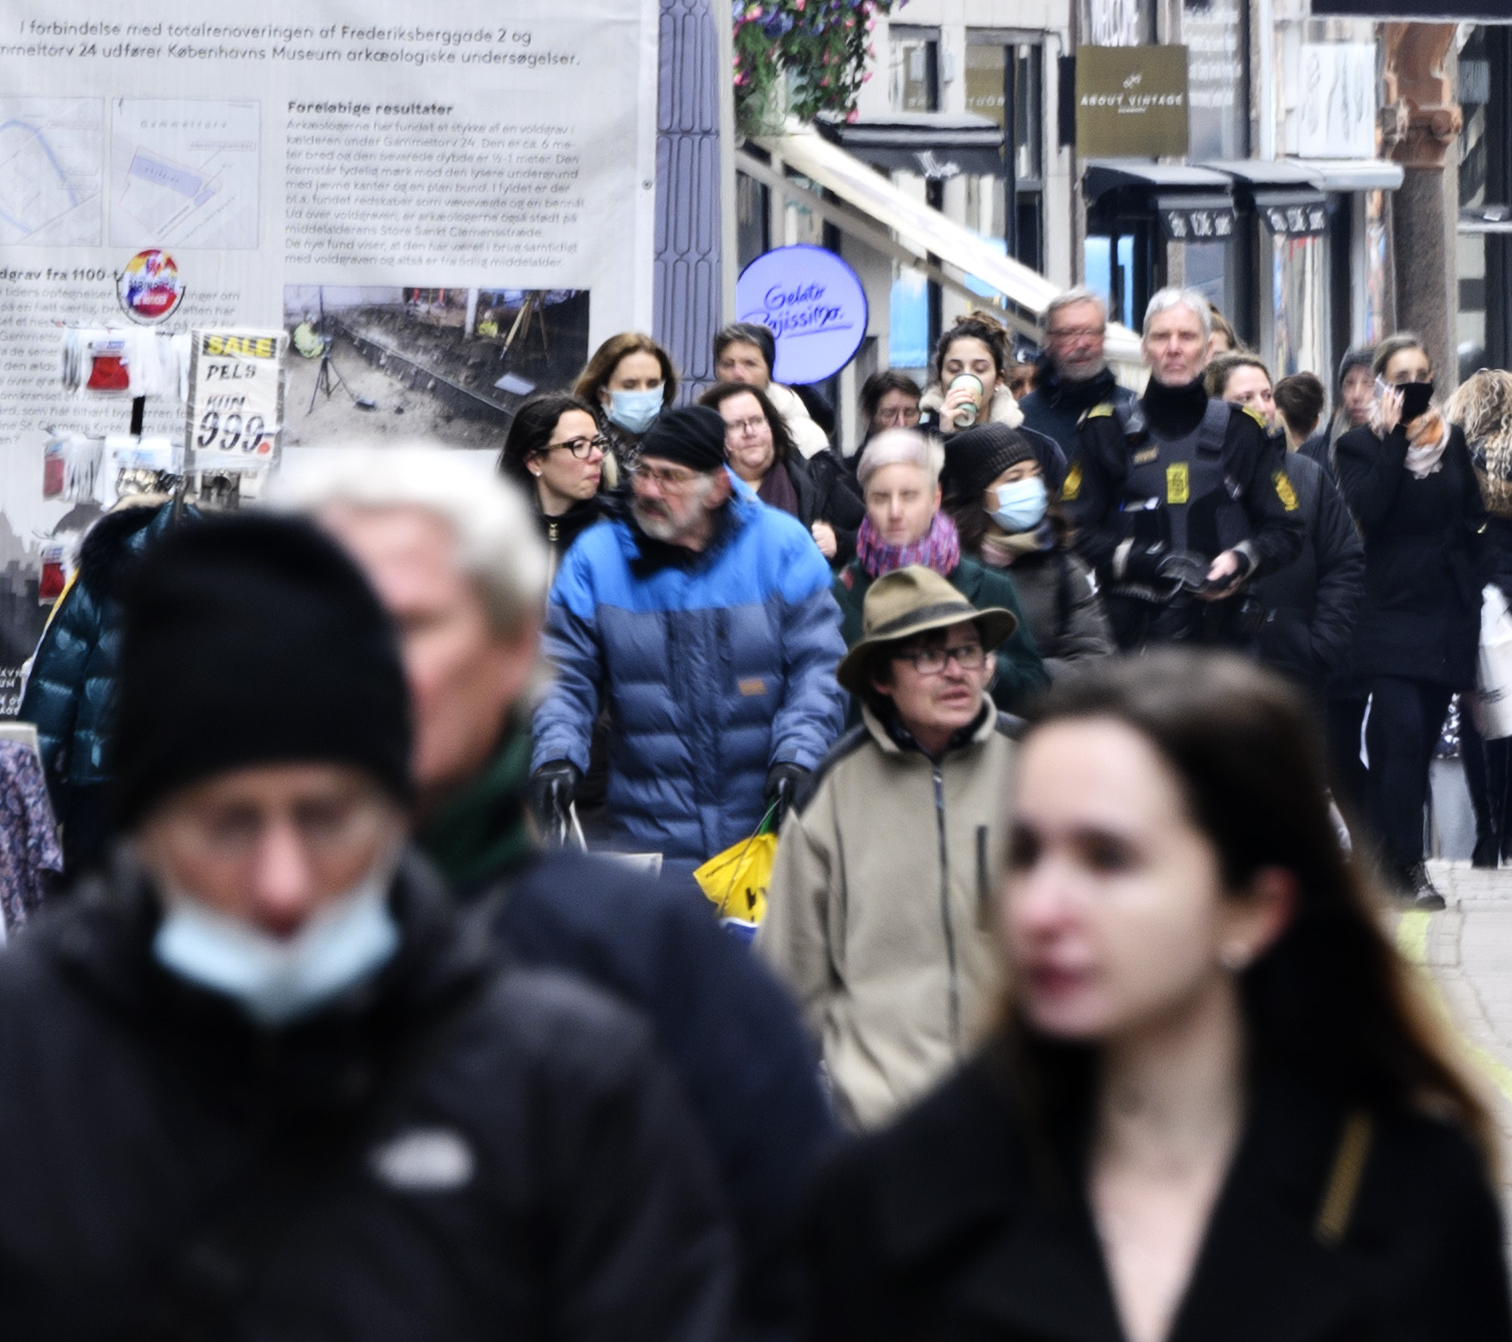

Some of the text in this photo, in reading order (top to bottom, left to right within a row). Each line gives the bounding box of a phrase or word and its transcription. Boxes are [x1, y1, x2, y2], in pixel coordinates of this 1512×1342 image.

[28, 19, 122, 38] forbindelse
[126, 22, 163, 38] med
[167, 22, 317, 43] totalrenoveringen
[319, 25, 338, 41] af
[341, 25, 493, 47] Frederiksberggade
[496, 29, 508, 45] 2
[511, 33, 533, 48] og
[78, 42, 99, 58] 24
[101, 42, 163, 60] udfører
[167, 43, 267, 61] Københavns
[271, 45, 342, 63] Museum
[345, 46, 458, 68] arkæologiske
[1080, 93, 1124, 106] ABOUT
[288, 101, 454, 118] Foreløbige resultater
[46, 268, 67, 281] fra
[764, 280, 826, 310] Gelato
[206, 335, 274, 357] SALE
[206, 364, 257, 381] PELS
